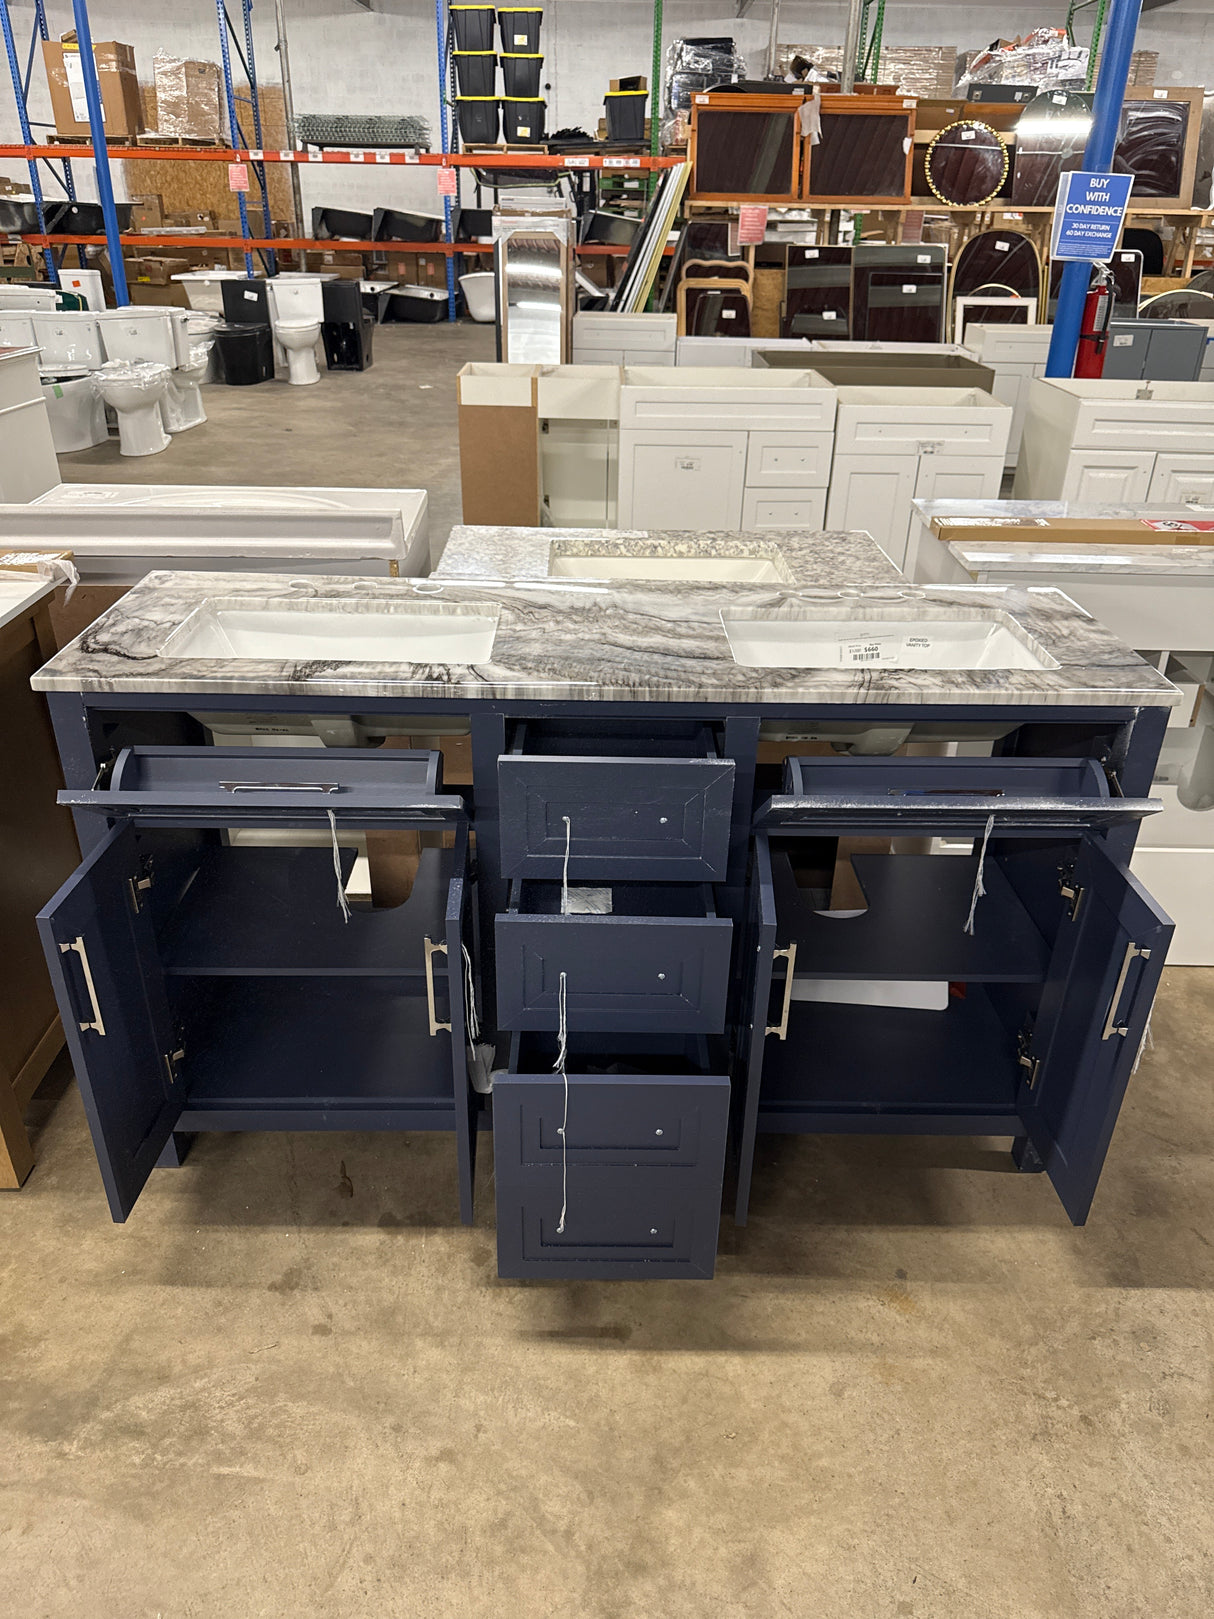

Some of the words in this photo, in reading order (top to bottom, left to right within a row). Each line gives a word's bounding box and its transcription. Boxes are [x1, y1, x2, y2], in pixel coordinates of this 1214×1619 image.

[1089, 178, 1110, 188] BUY
[1086, 191, 1110, 202] WITH
[1066, 203, 1123, 216] CONFIDENCE
